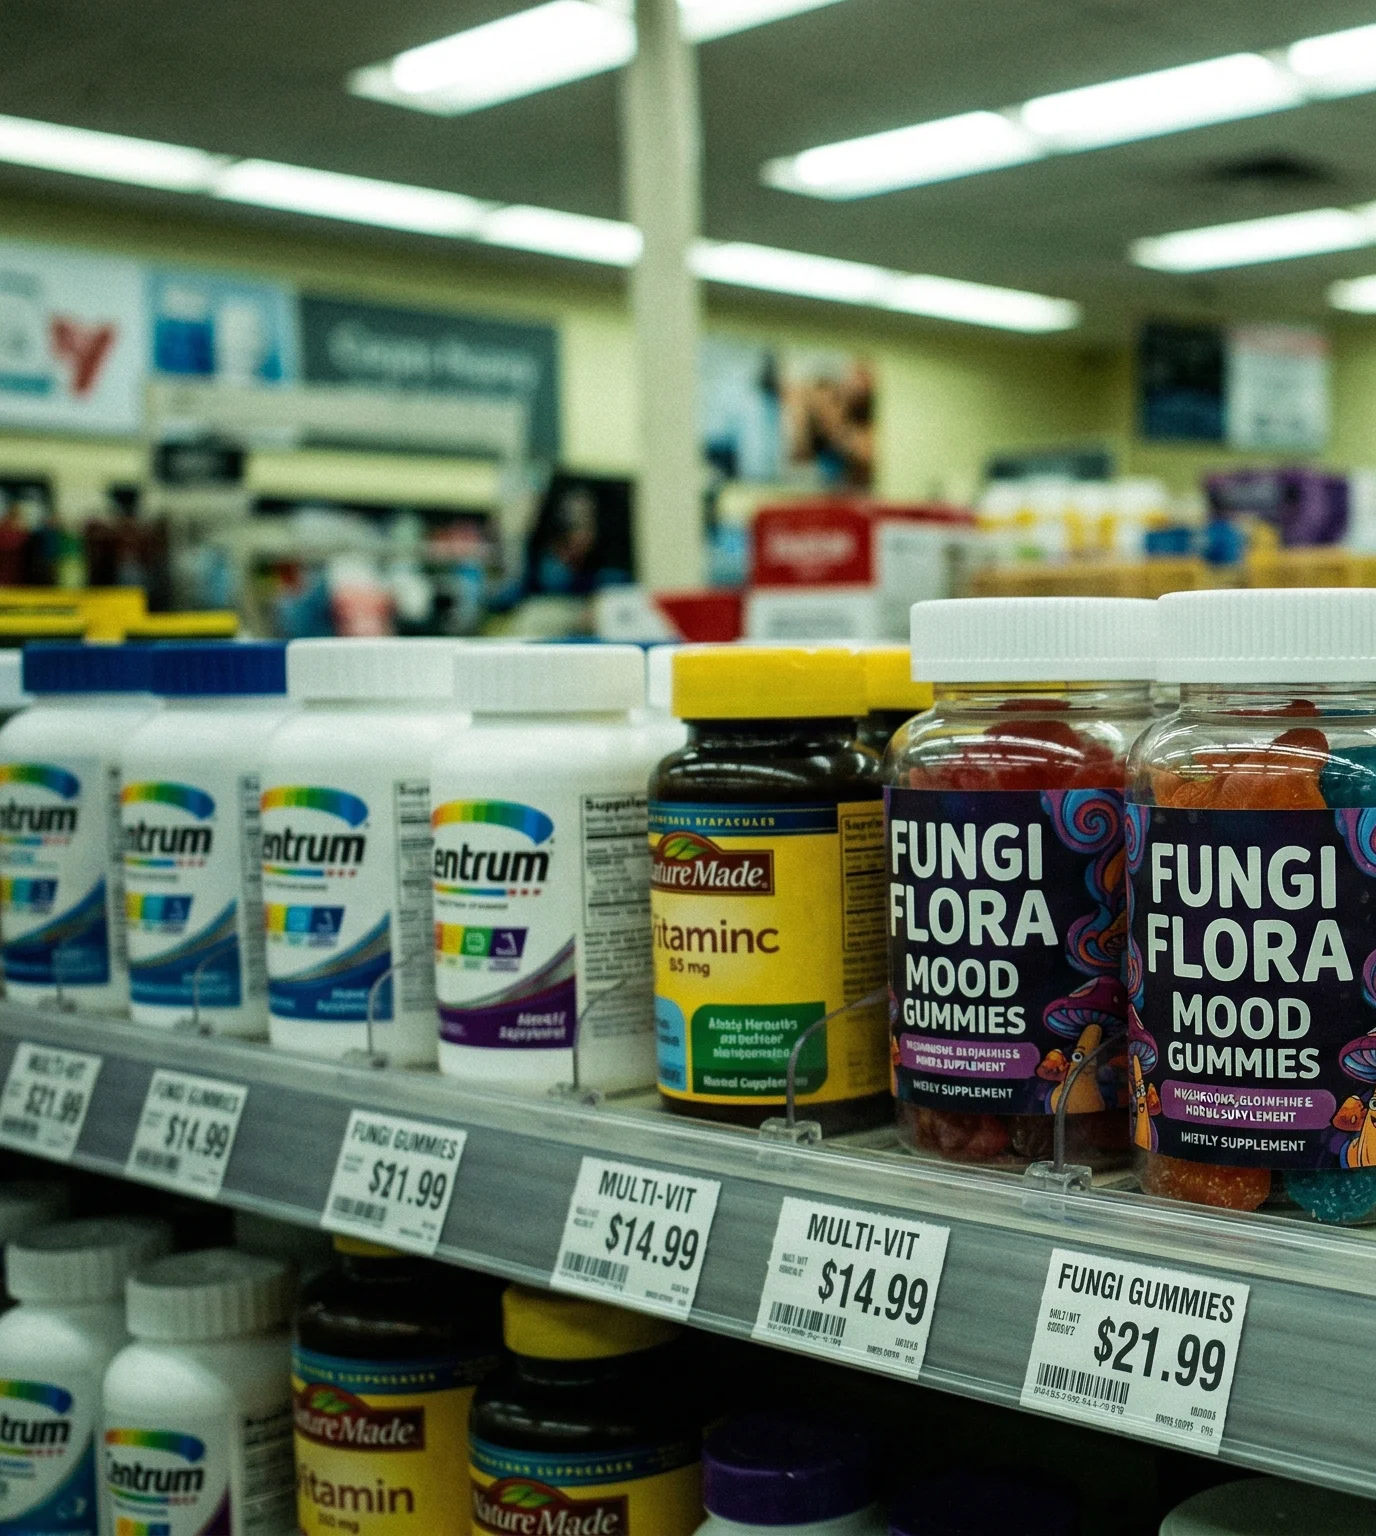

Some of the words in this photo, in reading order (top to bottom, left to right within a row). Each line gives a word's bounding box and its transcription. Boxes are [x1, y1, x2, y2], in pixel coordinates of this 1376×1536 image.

[891, 819, 1043, 881] FUNGI
[1152, 842, 1337, 910] FUNGI
[890, 882, 1059, 946] FLORA
[1148, 913, 1354, 982] FLORA
[906, 953, 1019, 998] MOOD
[903, 998, 1026, 1035] GUMMIES
[1173, 991, 1311, 1039] MOOD
[1168, 1041, 1321, 1079] GUMMIES
[941, 1084, 1014, 1099] SUPPLEMENT
[393, 1129, 458, 1162] GUMMIES
[1220, 1137, 1306, 1152] SUPPLEMENT
[598, 1170, 698, 1213] MULTI-VIT
[605, 1212, 699, 1271] $14.99
[806, 1213, 921, 1261] MULTI-VIT
[818, 1258, 928, 1325] $14.99
[1058, 1263, 1124, 1301] FUNGI
[1128, 1277, 1235, 1323] GUMMIES
[1093, 1316, 1226, 1392] $21.99
